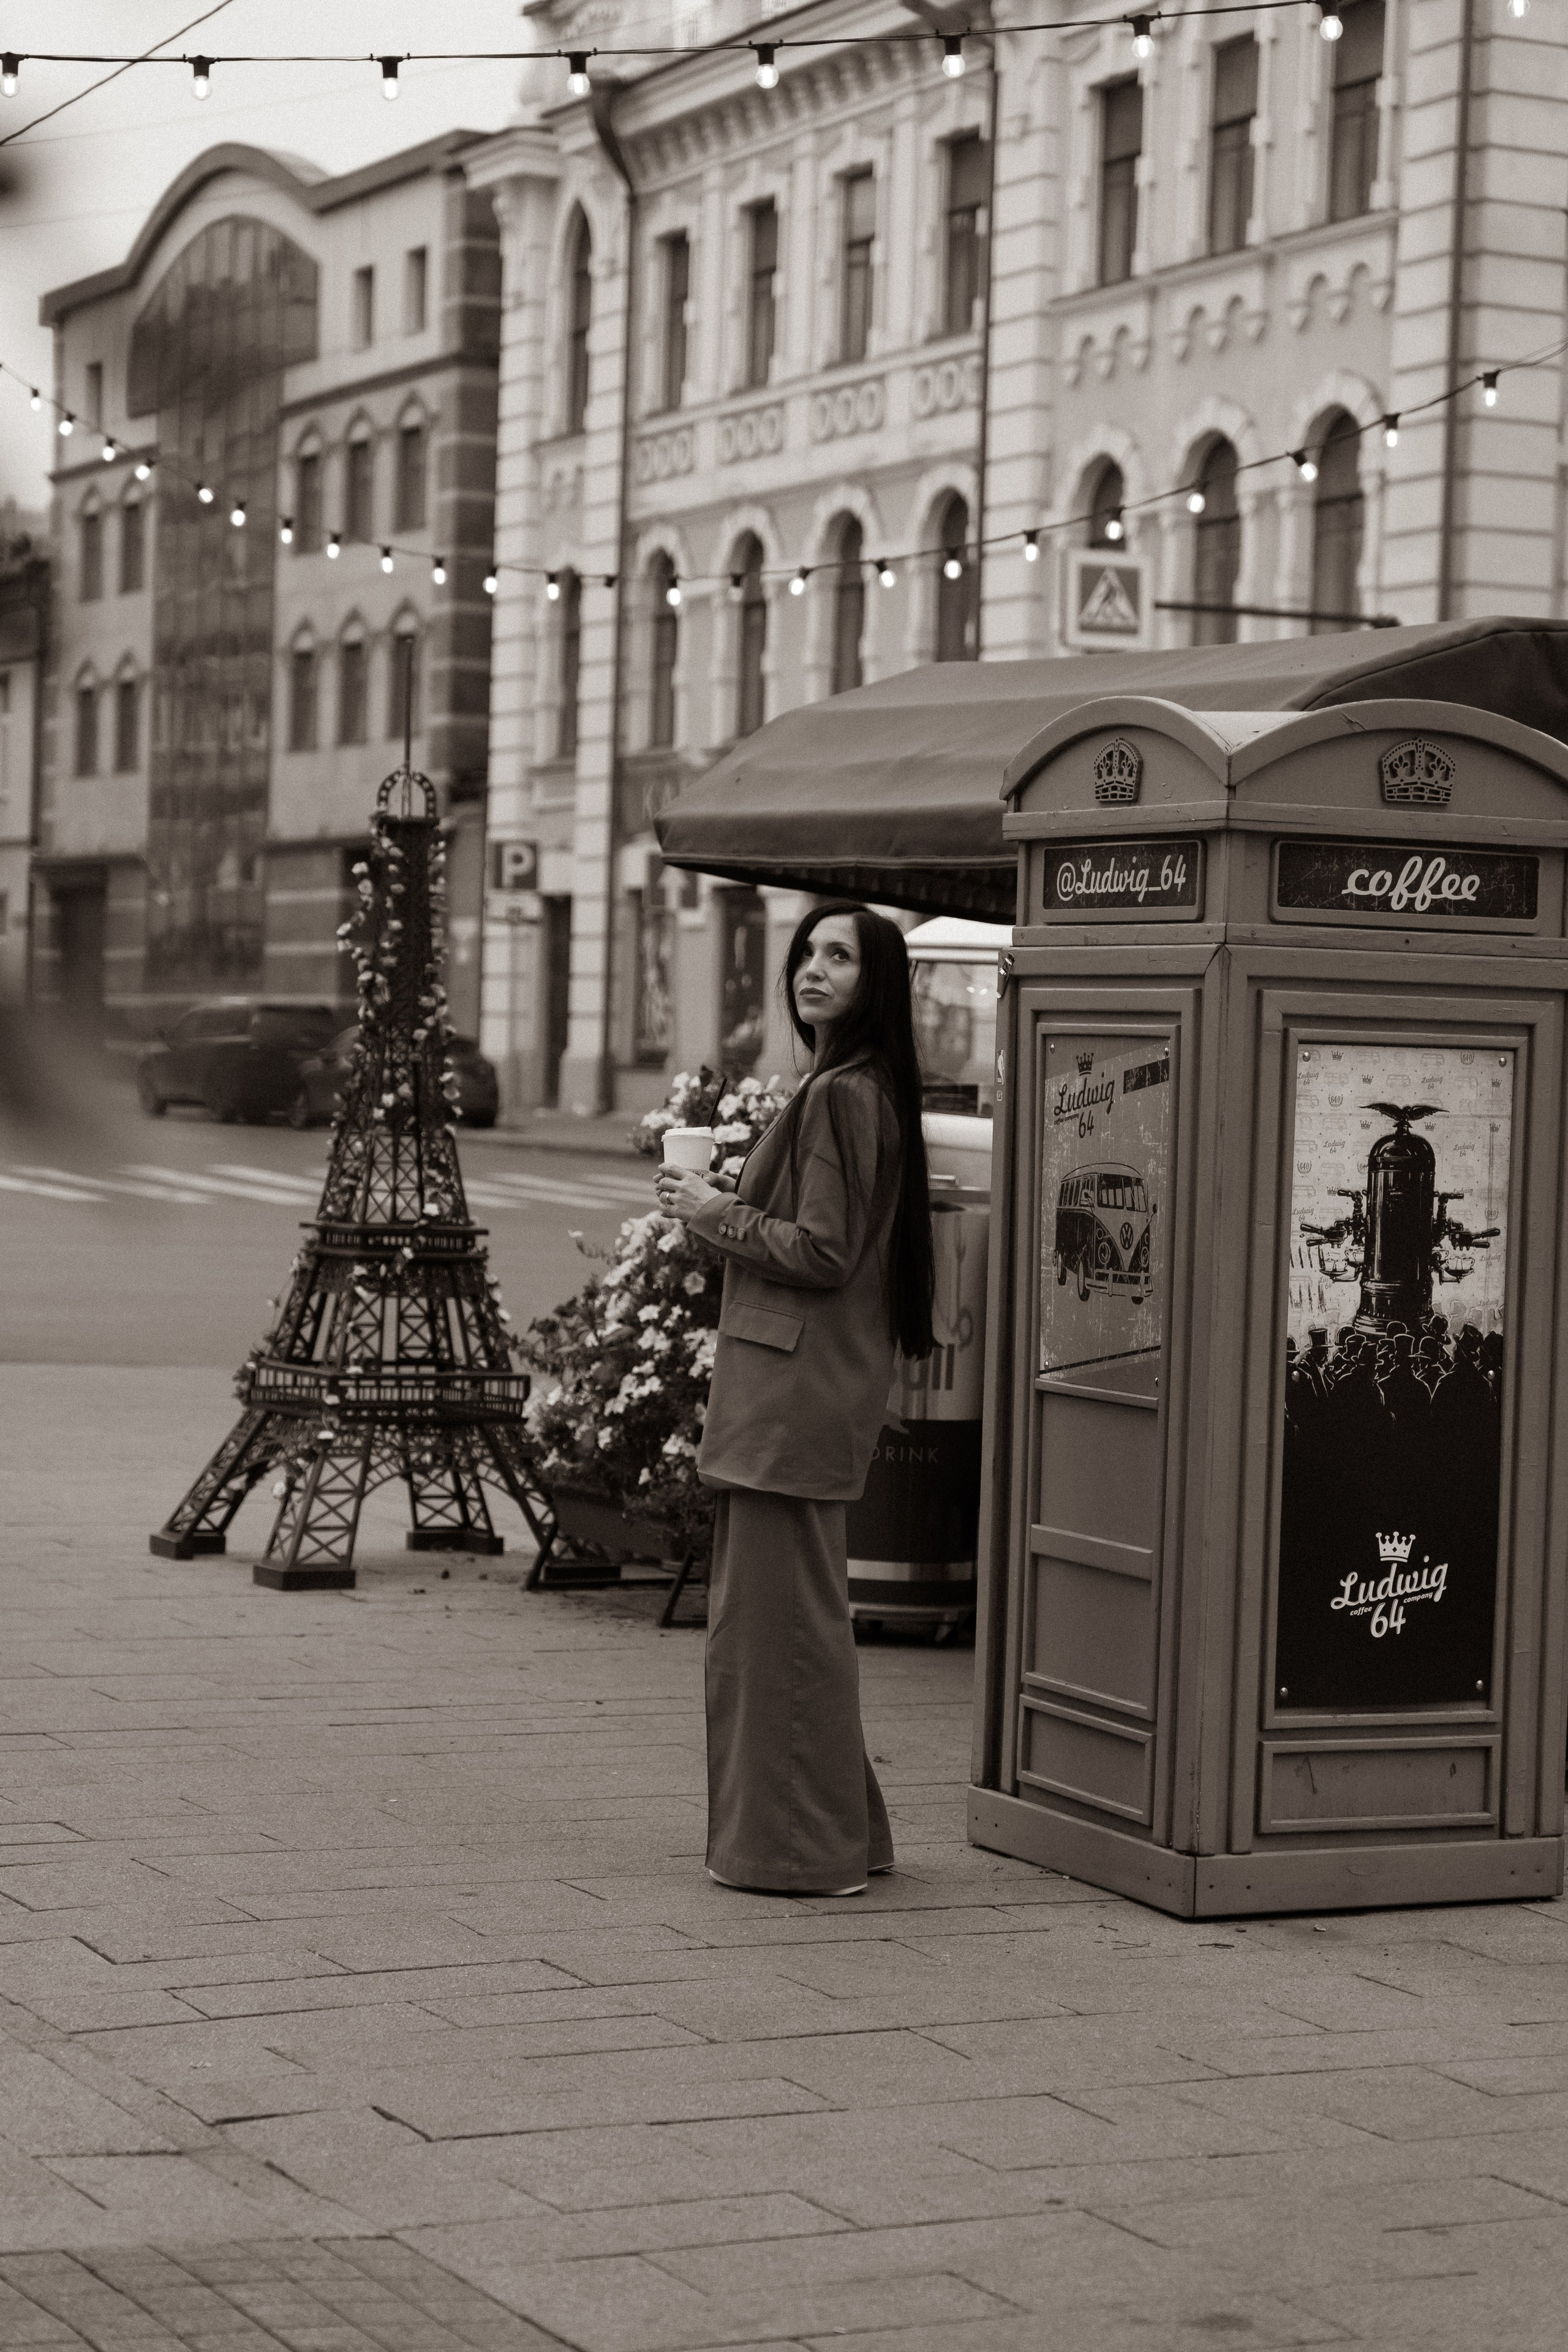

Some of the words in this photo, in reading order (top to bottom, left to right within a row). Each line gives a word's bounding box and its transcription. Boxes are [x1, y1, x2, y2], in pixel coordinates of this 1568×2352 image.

[501, 845, 532, 888] P
[1057, 854, 1186, 902] @Ludwig_64
[1341, 856, 1480, 911] coffee
[1297, 1071, 1319, 1080] Ludwig
[1421, 1076, 1443, 1084] Ludwig
[1054, 1072, 1115, 1116] Ludwig
[1330, 1095, 1341, 1104] 640
[1054, 1117, 1064, 1126] coffee
[1079, 1110, 1094, 1139] 64
[1323, 1139, 1346, 1148] Ludwig
[1453, 1142, 1475, 1152] Ludwig
[1292, 1207, 1314, 1216] Ludwig
[1479, 1253, 1501, 1262] Ludwig
[1478, 1298, 1499, 1307] Ludwig
[1330, 1555, 1449, 1610] Ludwig
[1349, 1606, 1373, 1616] coffee
[1403, 1592, 1433, 1604] company
[1370, 1599, 1406, 1638] 64
